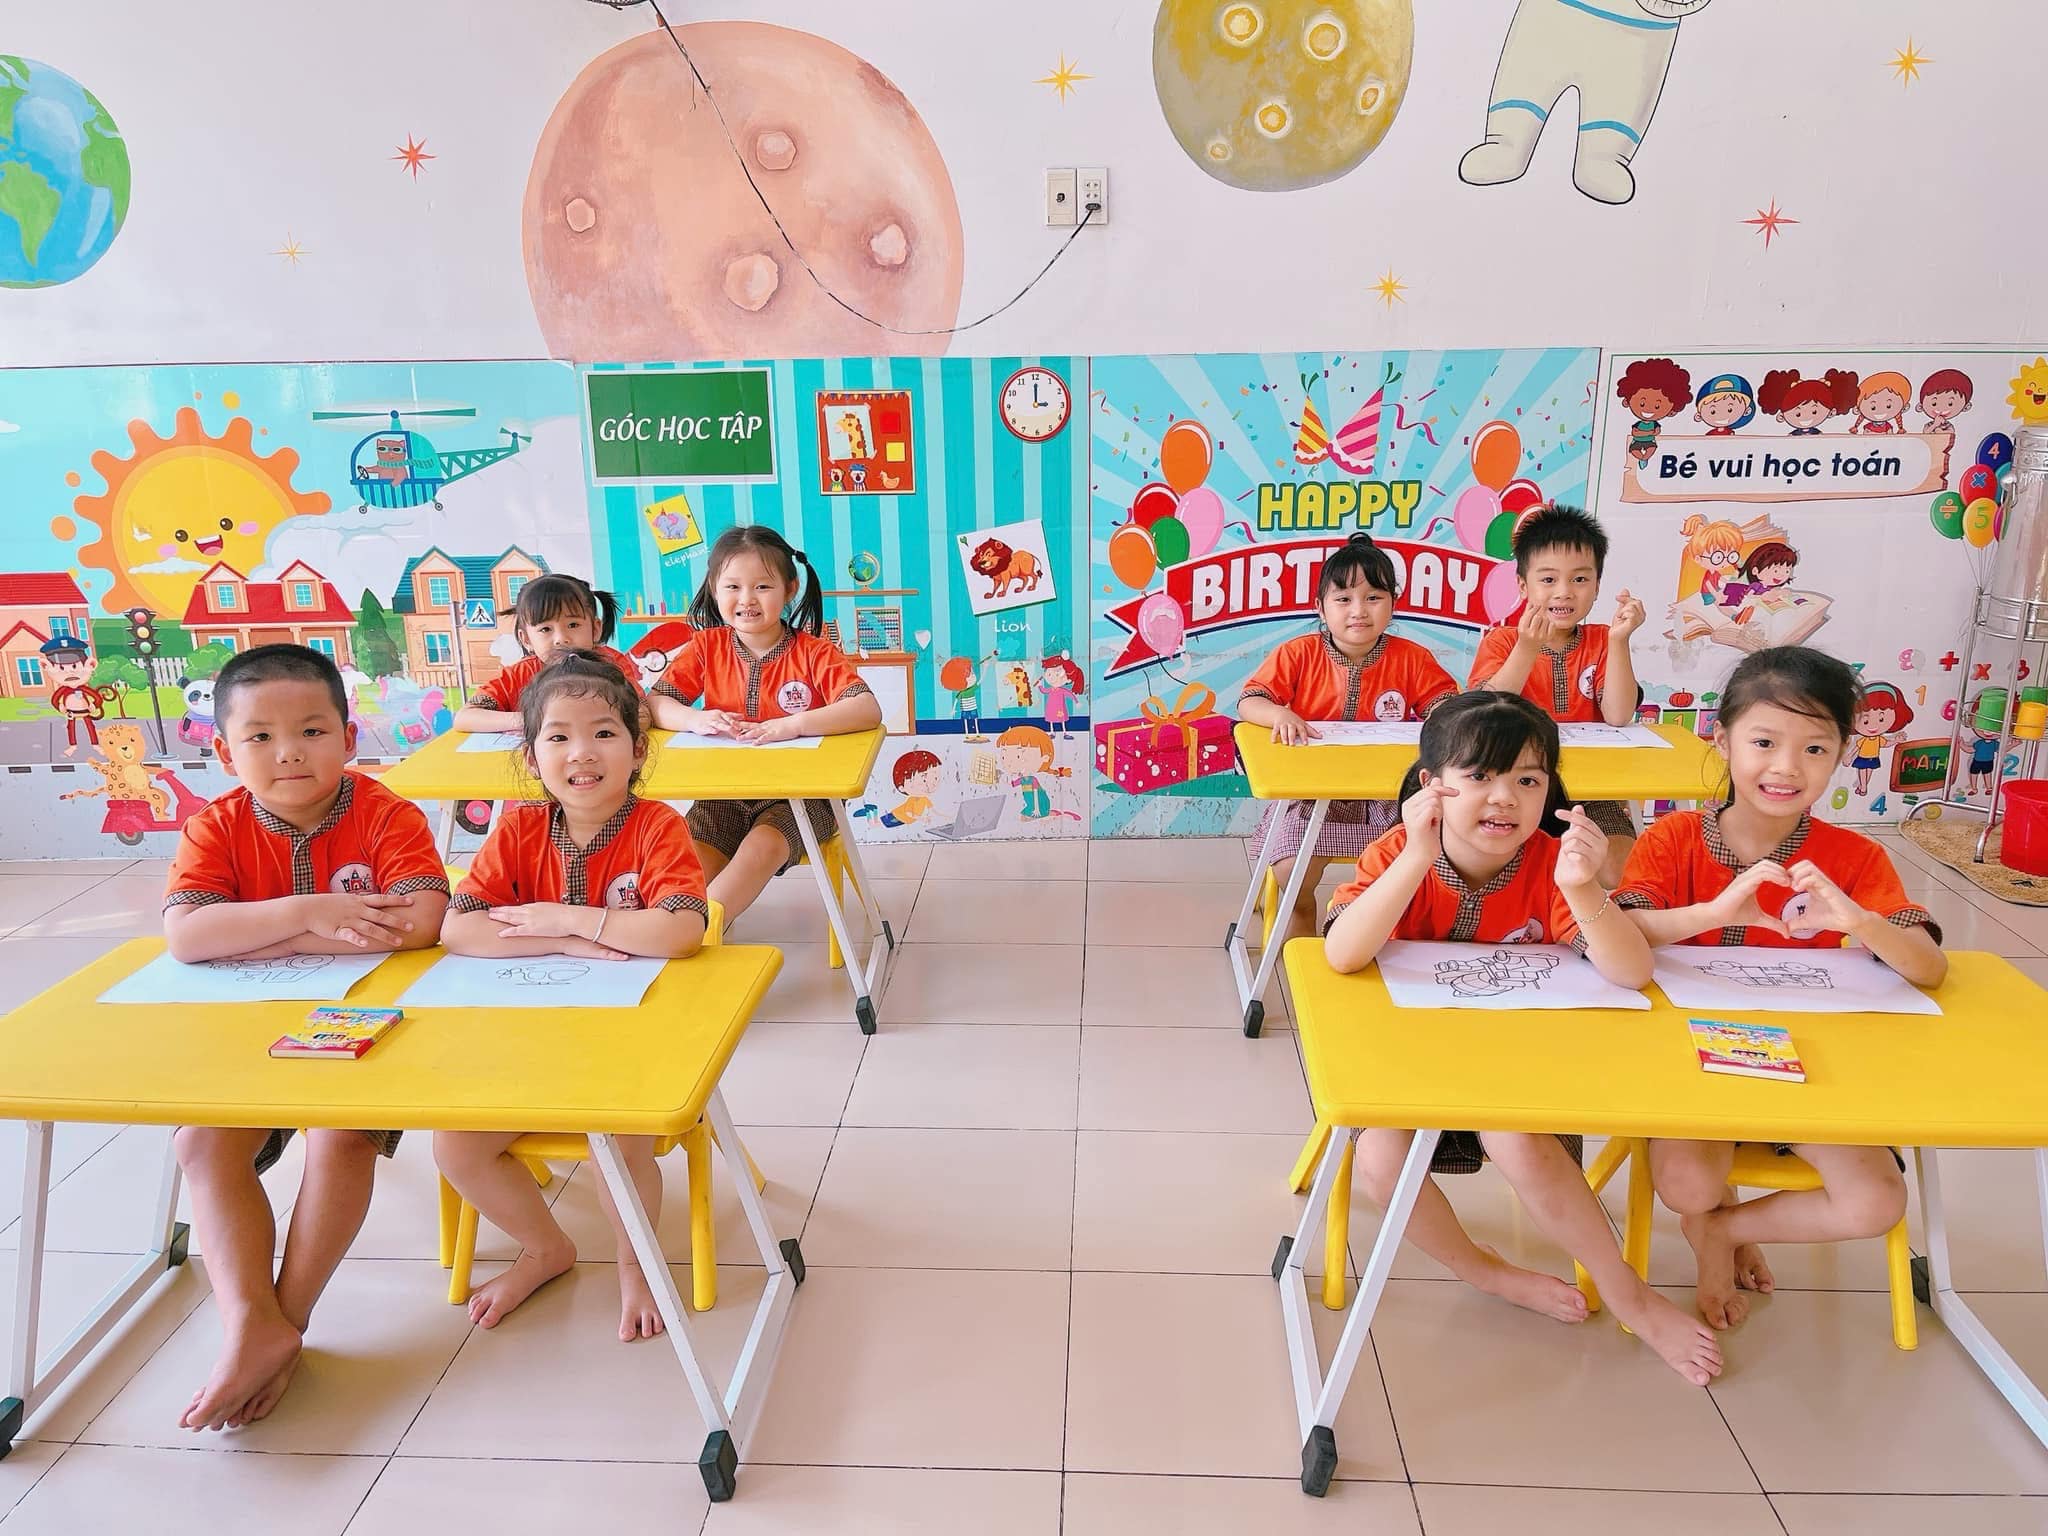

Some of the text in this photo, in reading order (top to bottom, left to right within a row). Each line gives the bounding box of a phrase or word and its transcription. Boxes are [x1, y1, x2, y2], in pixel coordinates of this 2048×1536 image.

[599, 410, 763, 445] GÓC HỌC TẬP
[1987, 442, 2000, 460] 4
[1659, 450, 1901, 484] Bé vui học toán
[1257, 480, 1422, 532] HAPPY
[1974, 506, 1990, 529] 5
[1915, 684, 1927, 706] 1
[2003, 754, 2020, 776] 2
[1870, 793, 1888, 816] 4
